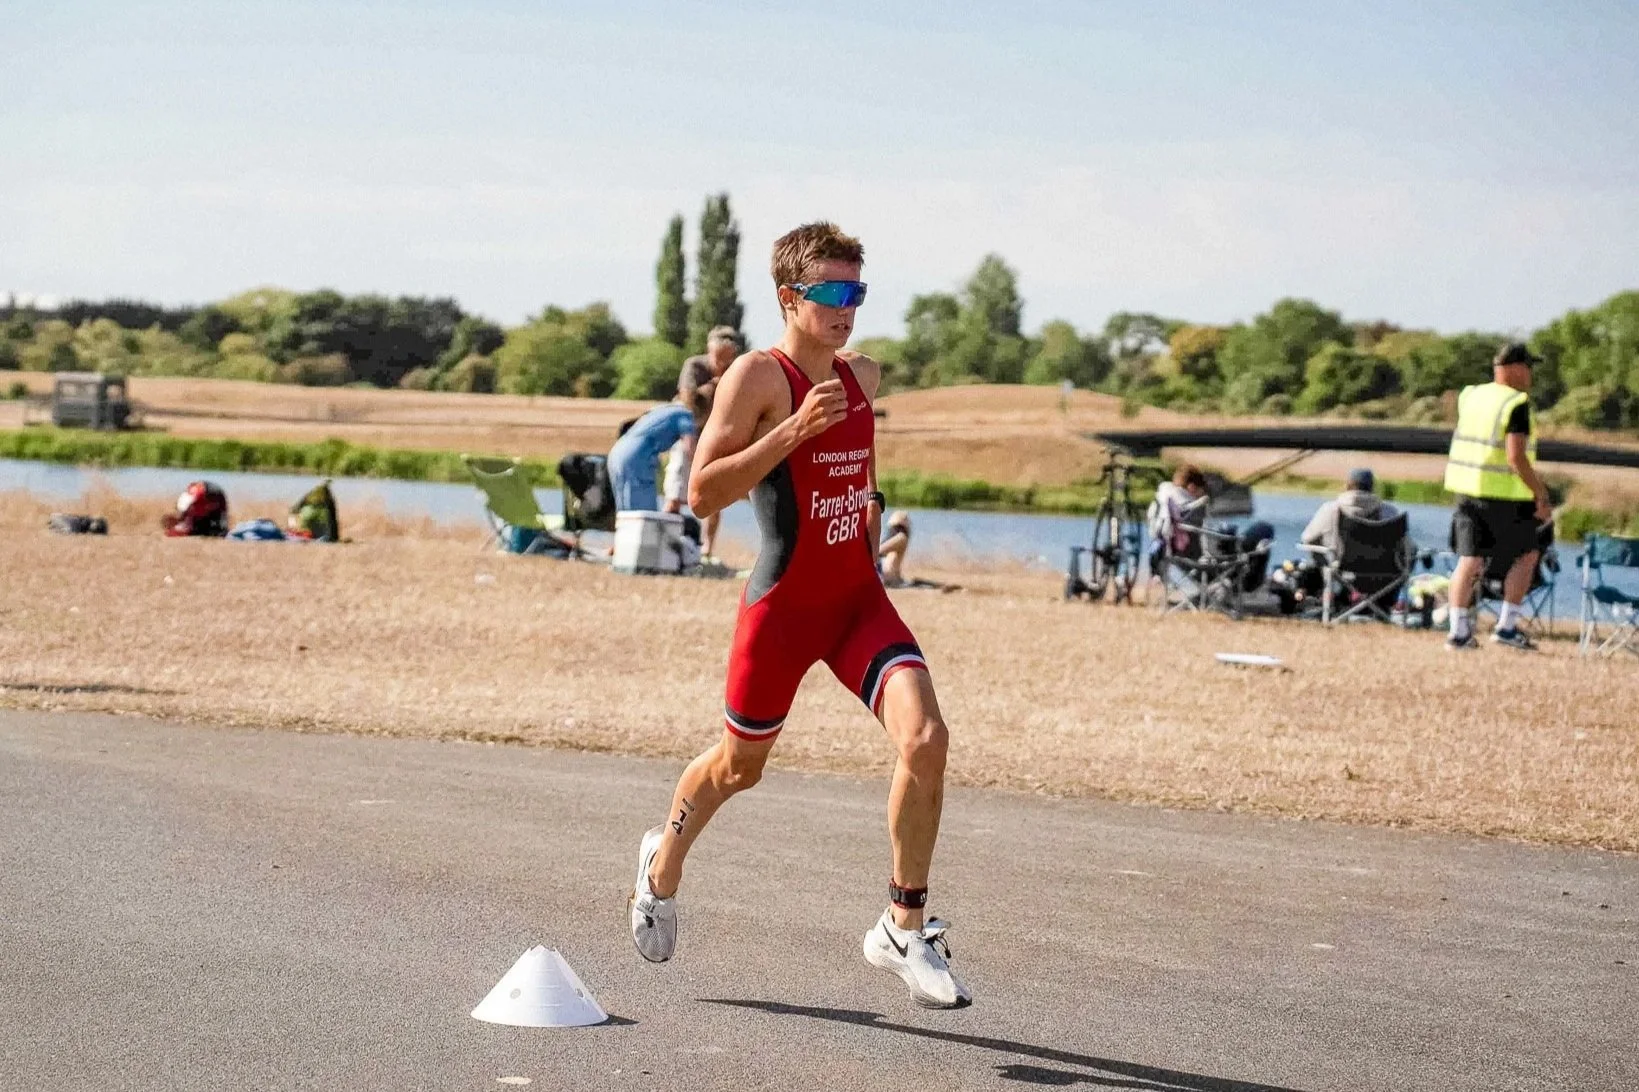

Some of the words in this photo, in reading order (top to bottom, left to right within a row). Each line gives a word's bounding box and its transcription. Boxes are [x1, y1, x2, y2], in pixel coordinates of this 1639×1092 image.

[812, 451, 847, 464] LONDON
[828, 462, 863, 478] ACADEMY
[810, 484, 869, 520] Farrer-Brow
[826, 512, 860, 545] GBR
